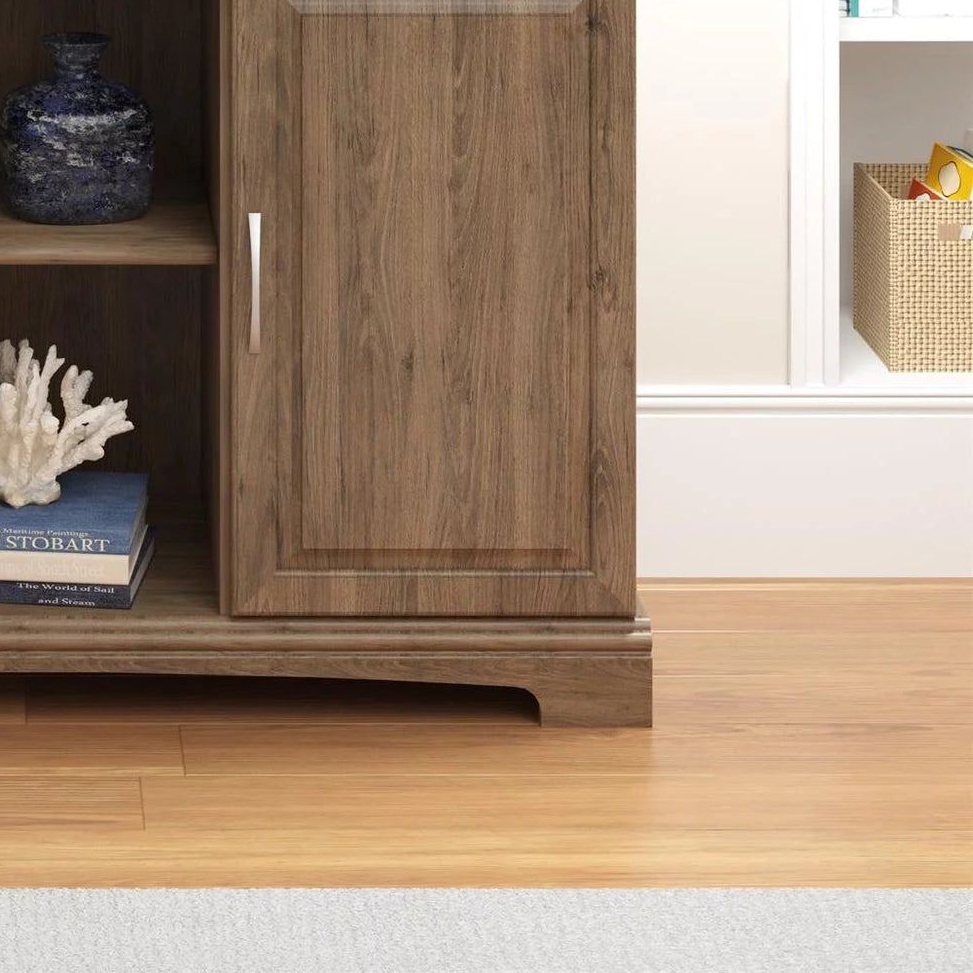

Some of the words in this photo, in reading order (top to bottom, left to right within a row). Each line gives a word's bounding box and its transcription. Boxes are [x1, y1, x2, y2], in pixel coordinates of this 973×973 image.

[3, 527, 44, 535] Maritime
[47, 529, 89, 538] Paintings
[6, 535, 110, 552] STOBART
[17, 582, 40, 590] The
[41, 583, 78, 592] World
[80, 584, 92, 593] of
[93, 585, 115, 594] Sail
[37, 597, 59, 605] and
[61, 598, 96, 607] Steam
